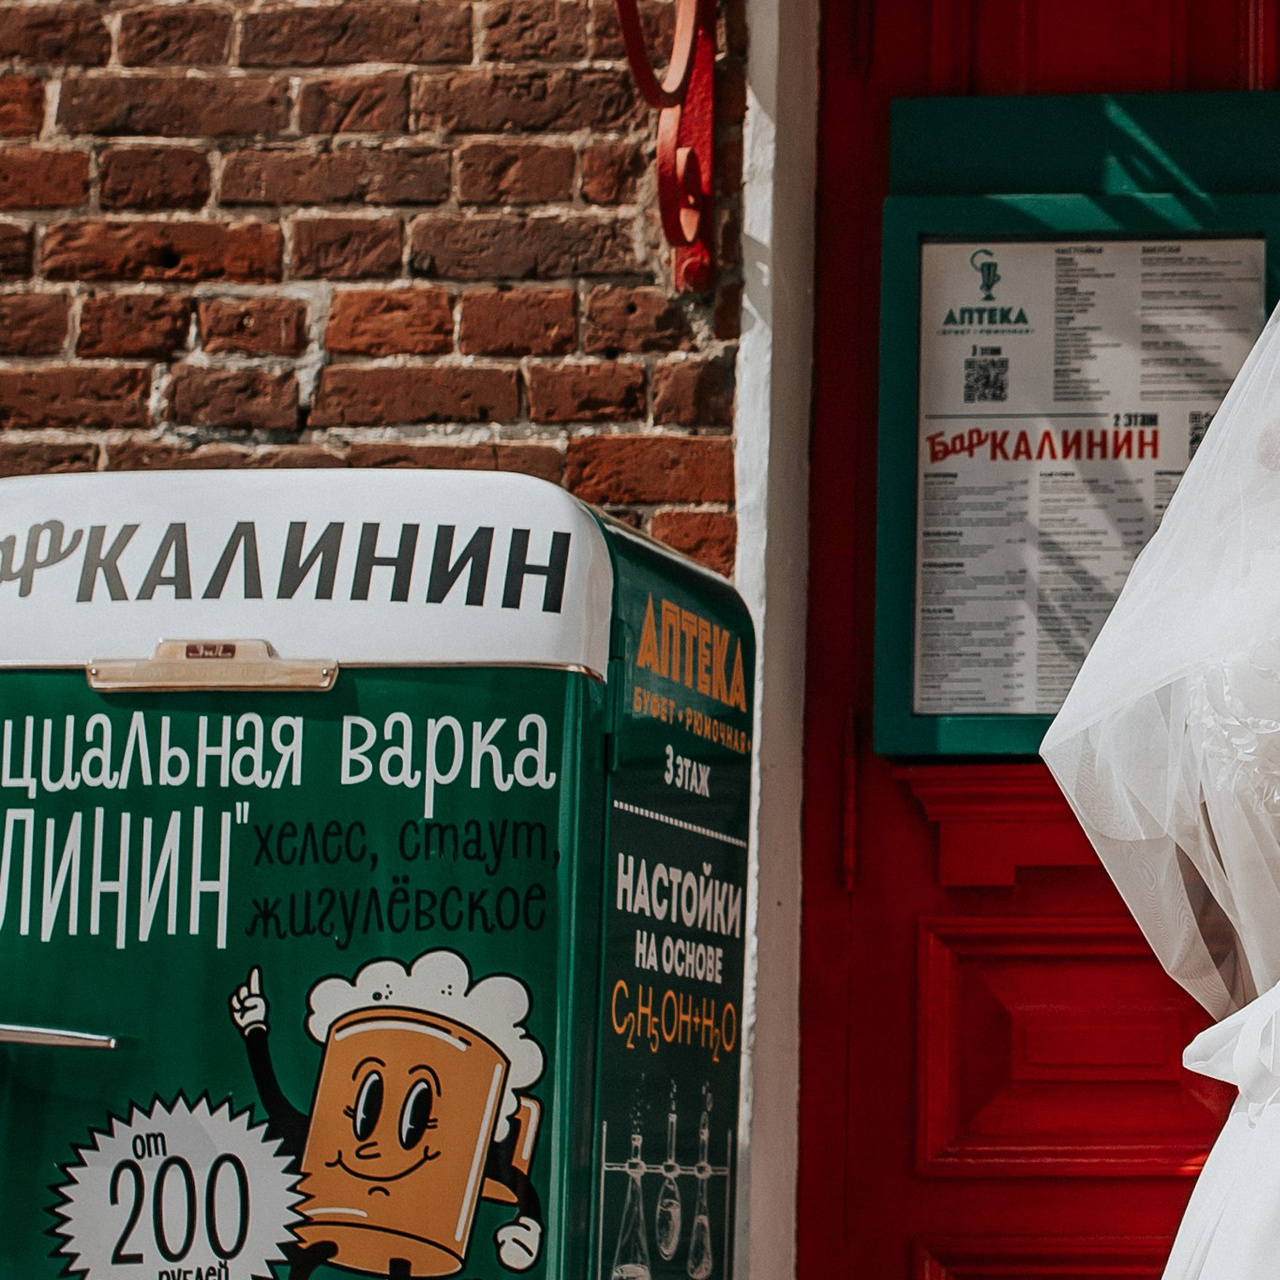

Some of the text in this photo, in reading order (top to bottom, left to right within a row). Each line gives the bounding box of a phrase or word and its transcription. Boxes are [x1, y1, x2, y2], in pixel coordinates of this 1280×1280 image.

[943, 307, 1029, 327] АПТЕКА
[637, 592, 746, 712] АПТЕКА
[633, 686, 675, 725] БУФЕТ
[2, 711, 556, 818] циальная варка
[664, 744, 710, 798] 3 ЭТАЖ
[253, 819, 562, 876] хелес, стаут,
[246, 875, 547, 951] жигулёвское
[618, 853, 742, 939] НАСТОЙКИ
[635, 929, 722, 985] НА ОСНОВЕ
[132, 1131, 167, 1160] от
[109, 1152, 251, 1268] 200
